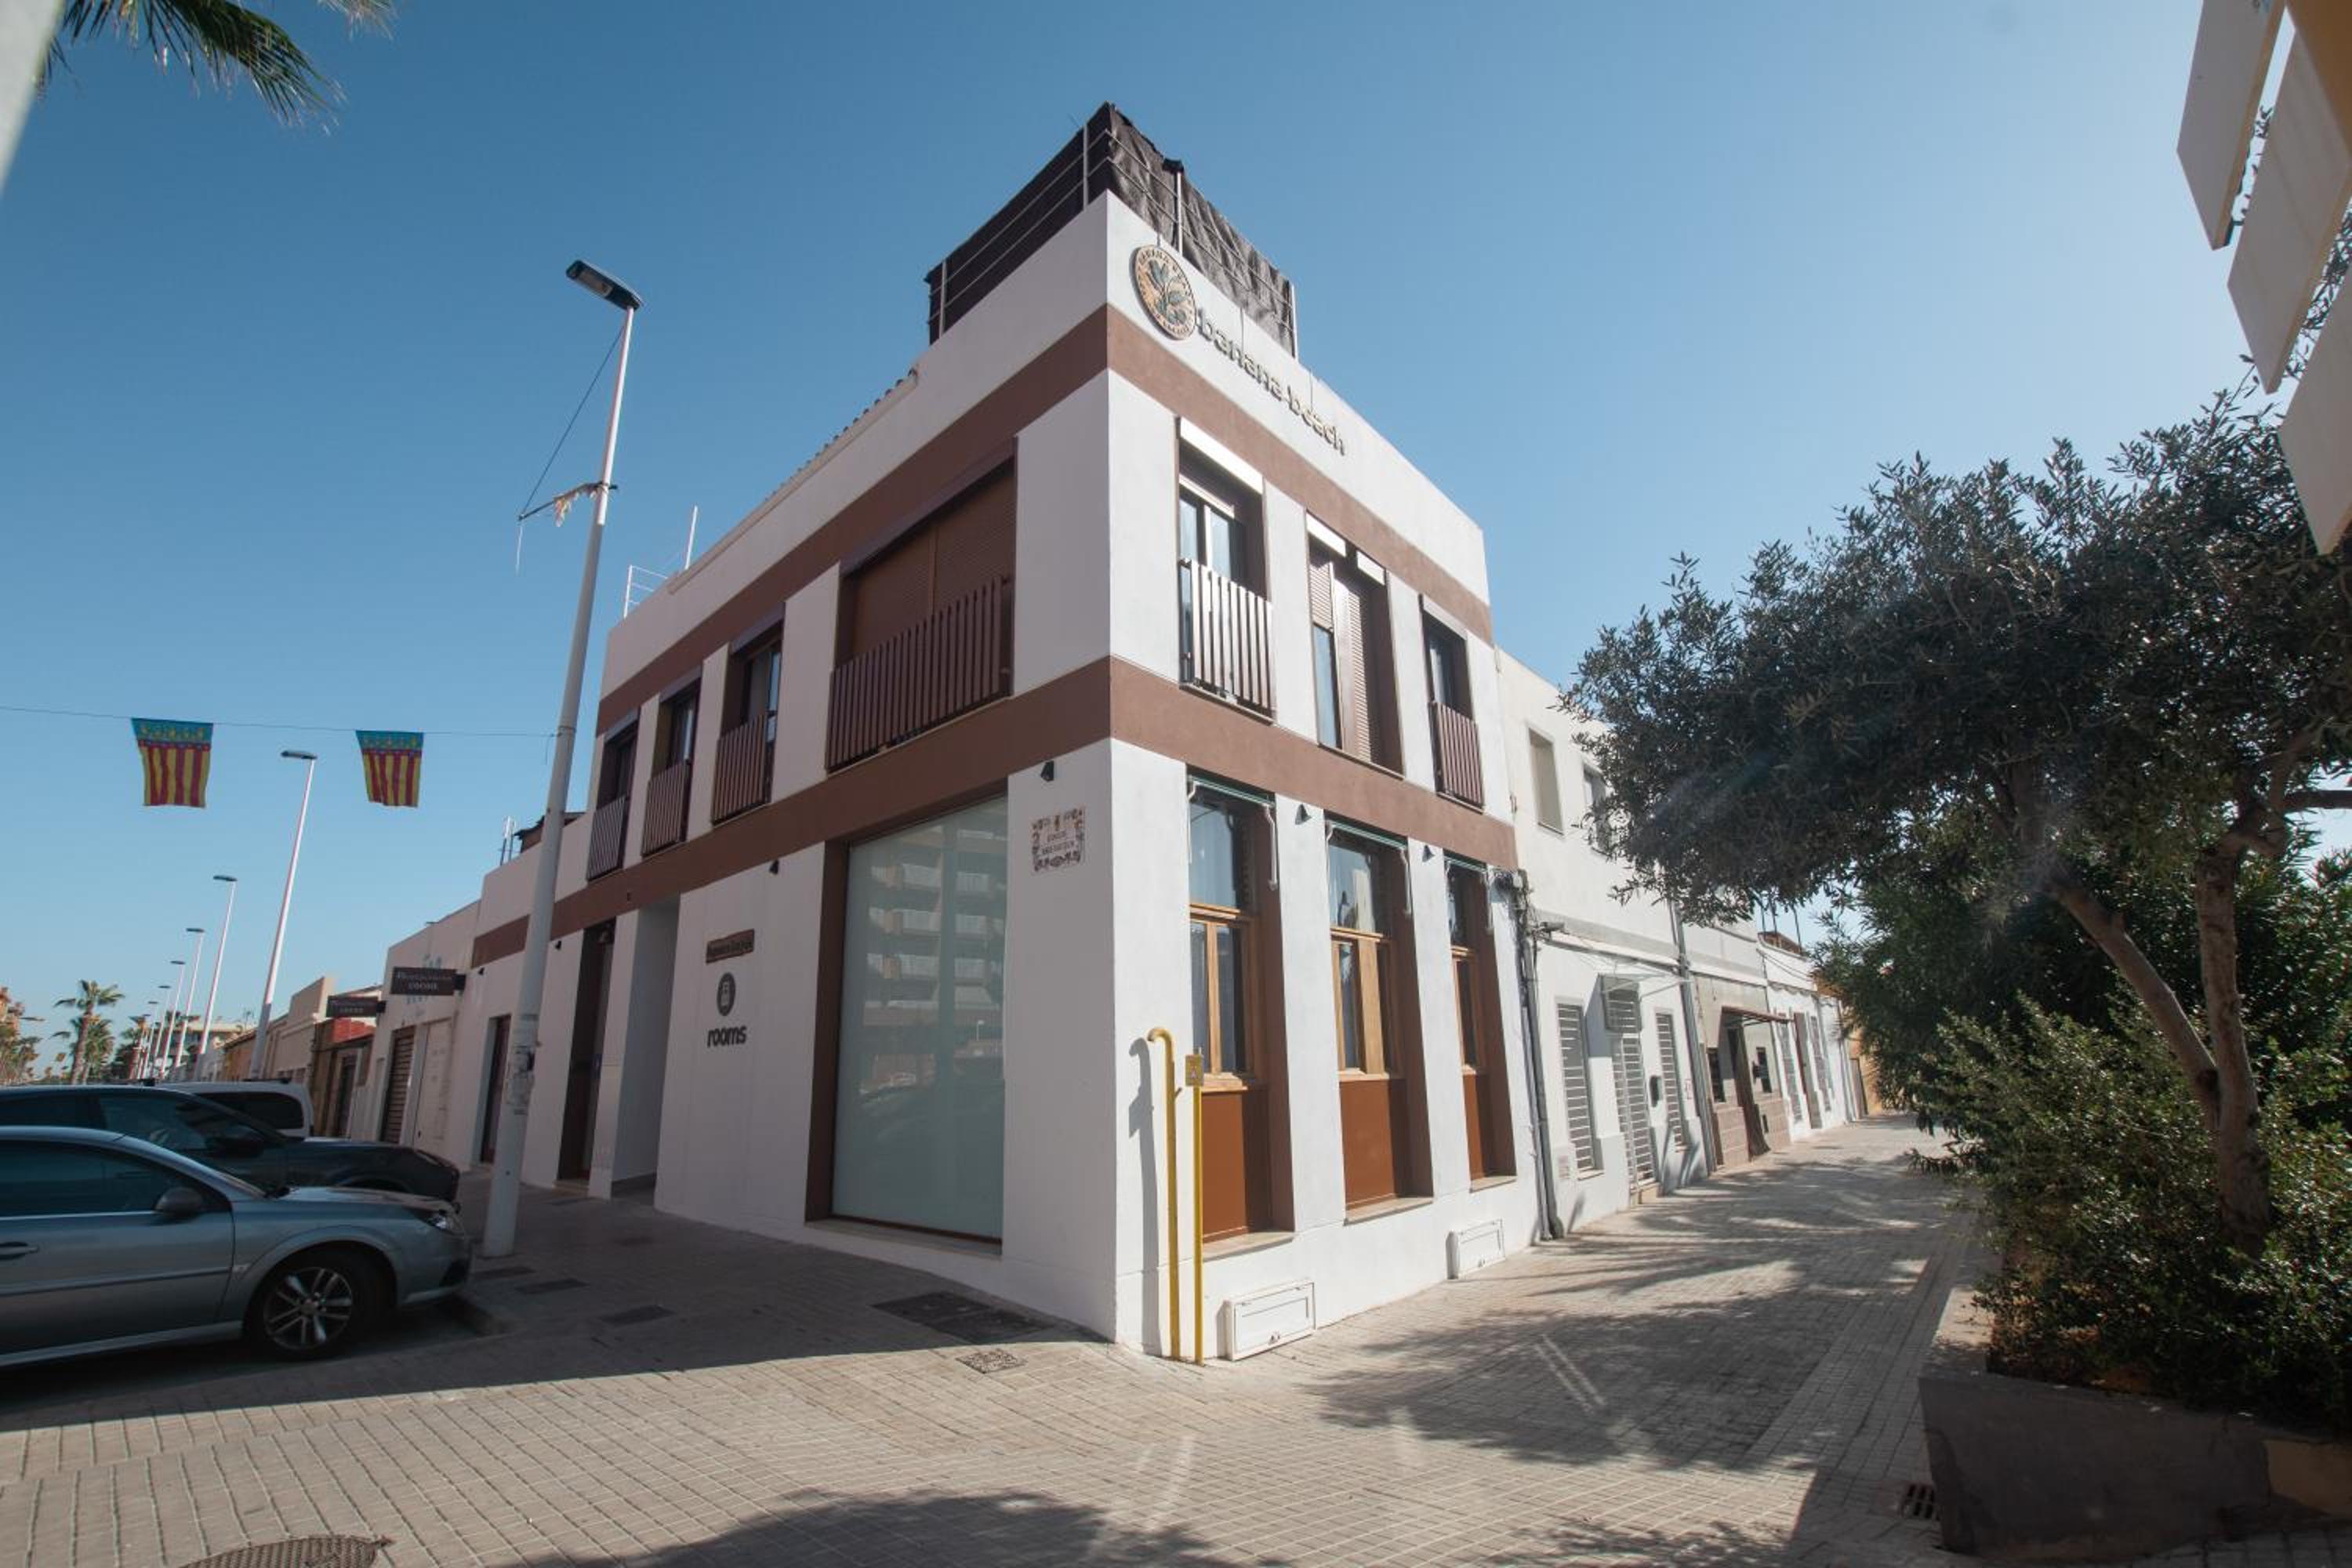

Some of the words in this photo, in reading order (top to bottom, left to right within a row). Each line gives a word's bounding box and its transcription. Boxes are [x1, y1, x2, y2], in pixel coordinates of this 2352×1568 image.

[1198, 308, 1283, 402] banana
[1287, 385, 1345, 456] beach
[707, 1025, 747, 1048] rooms
